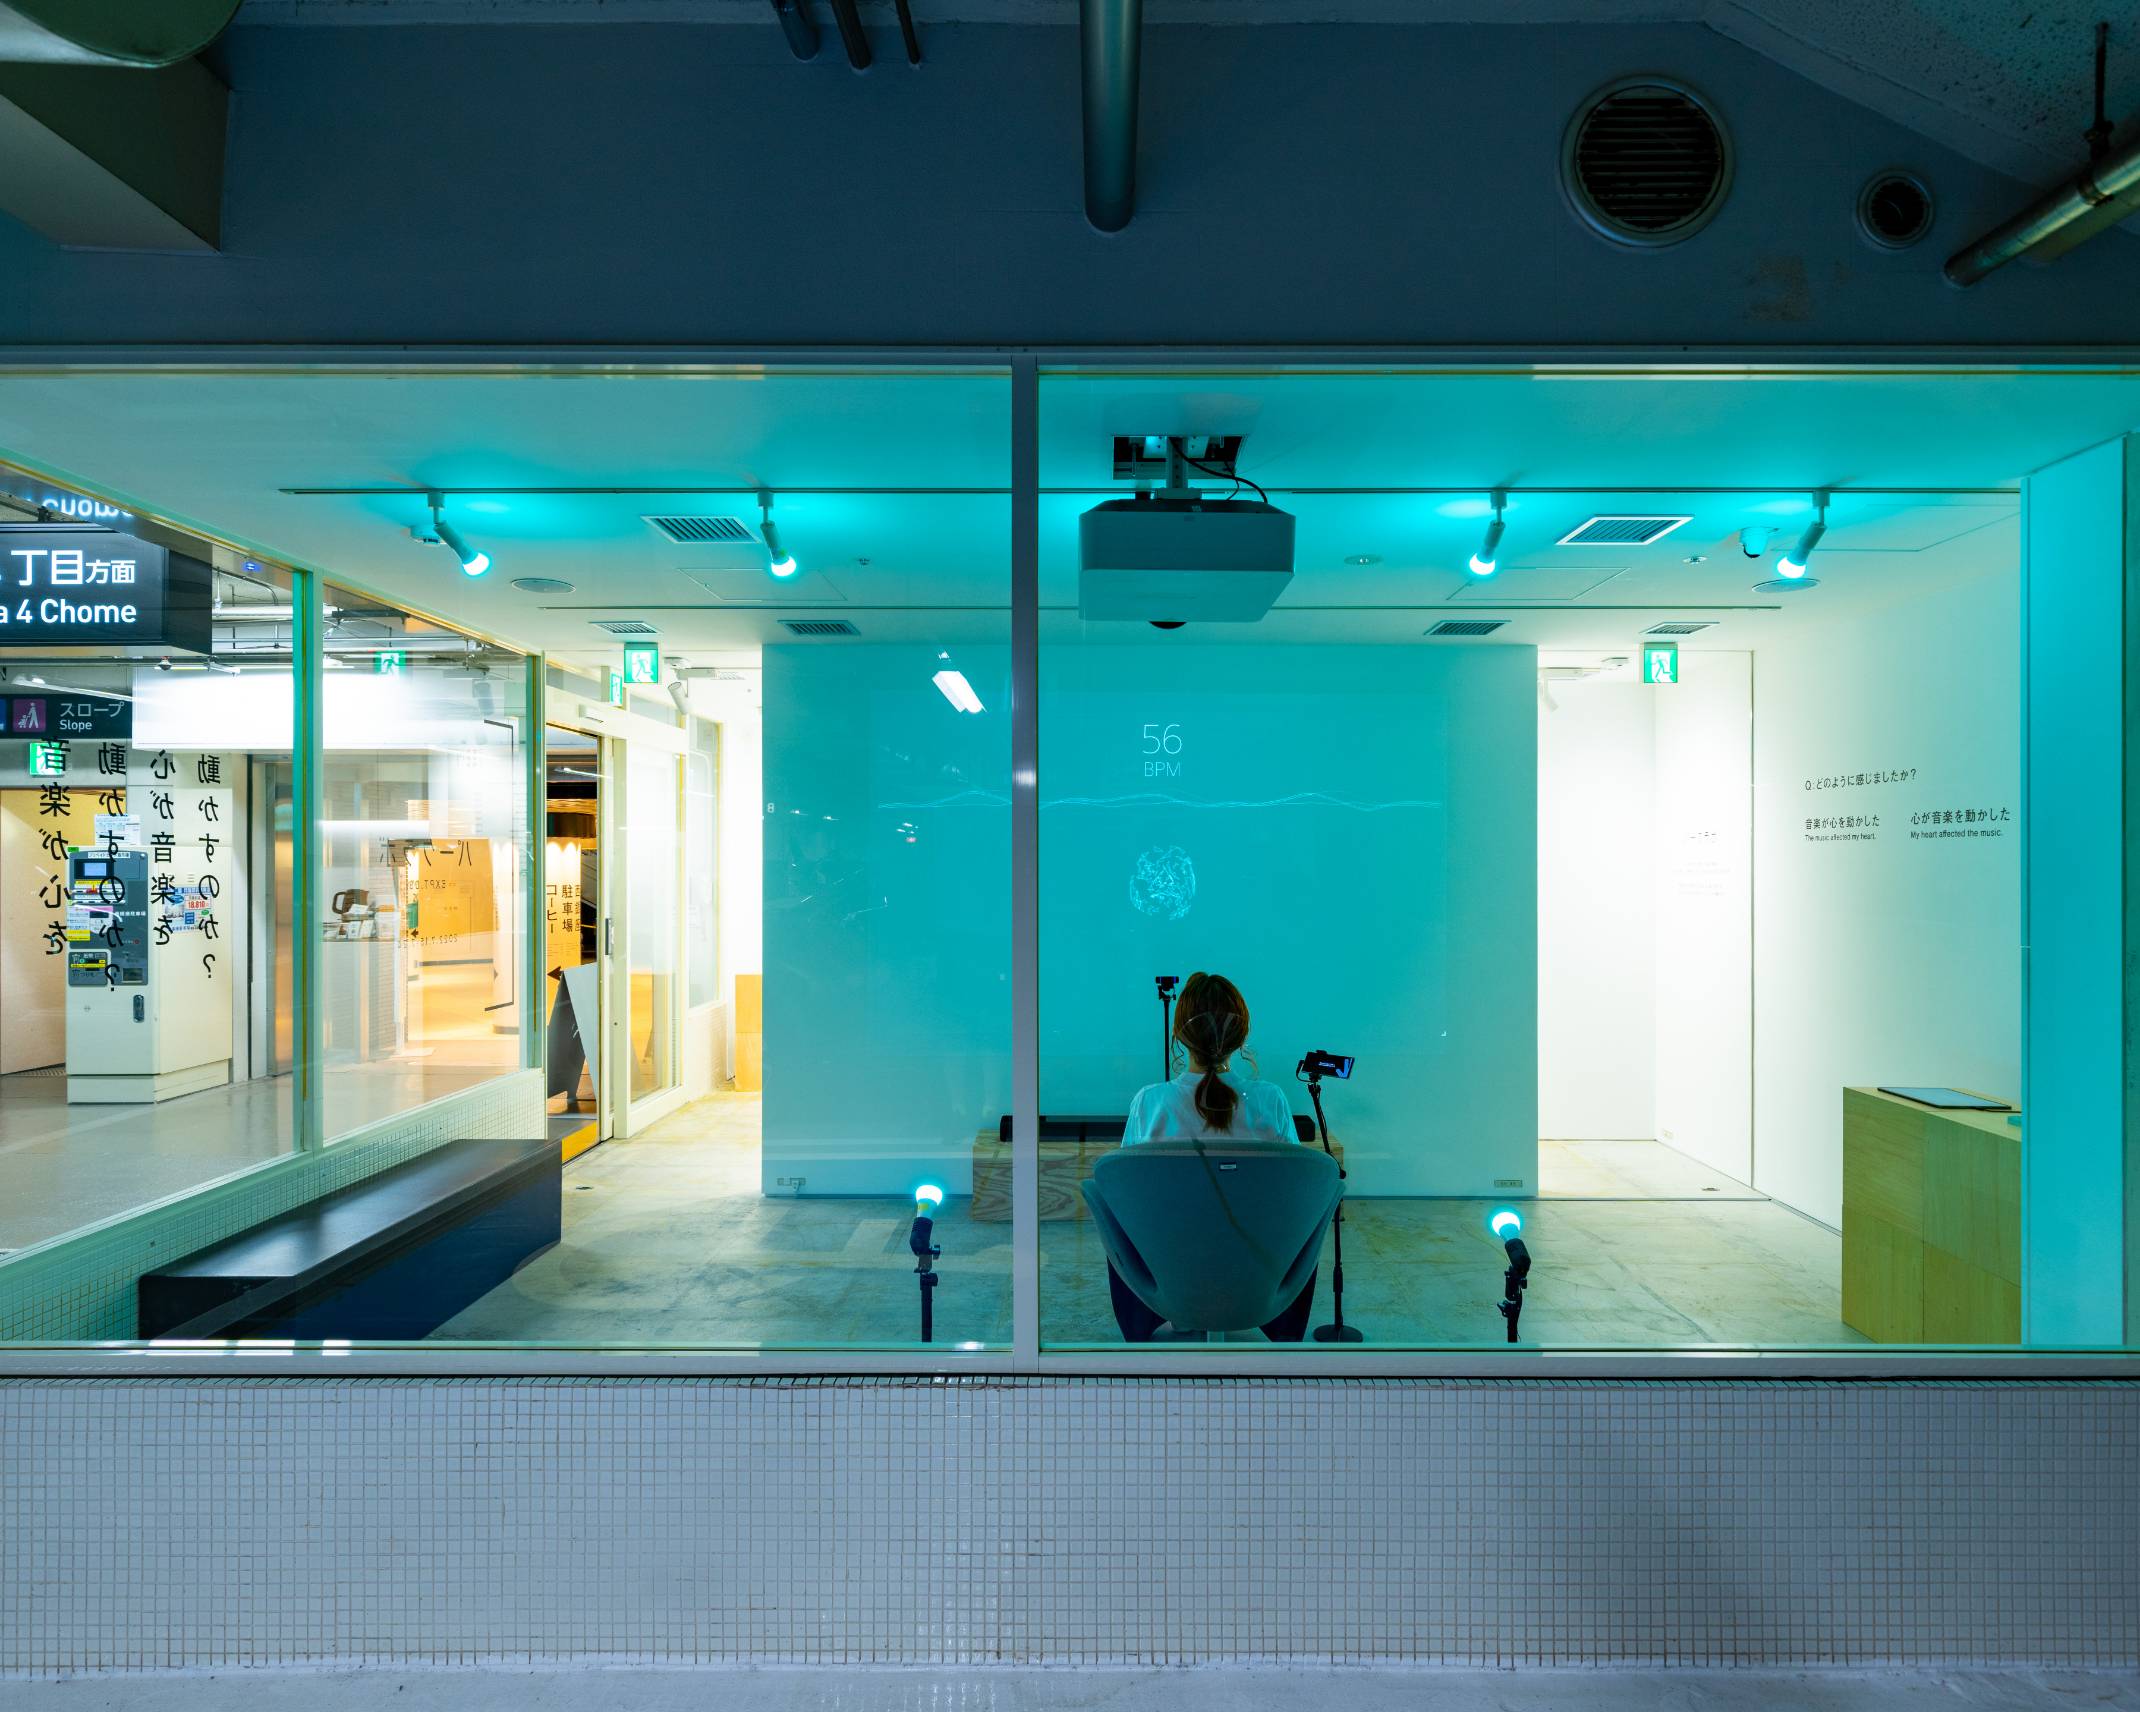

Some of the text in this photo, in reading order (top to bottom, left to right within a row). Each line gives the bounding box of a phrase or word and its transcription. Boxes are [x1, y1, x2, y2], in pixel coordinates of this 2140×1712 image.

[16, 599, 33, 624] 4
[40, 598, 137, 624] Chome
[60, 701, 125, 718] スロープ
[59, 719, 93, 733] Slope
[1142, 723, 1183, 755] 56
[1143, 761, 1181, 777] BPM
[1805, 814, 1880, 830] 音楽が心を動かした
[1910, 807, 2011, 825] 心が音楽を動かした
[1910, 831, 1920, 840] My
[1921, 831, 1938, 839] heart
[1939, 829, 1966, 838] affected
[1967, 829, 1979, 837] the
[546, 884, 558, 934] コーヒー
[561, 884, 573, 933] 駐車場
